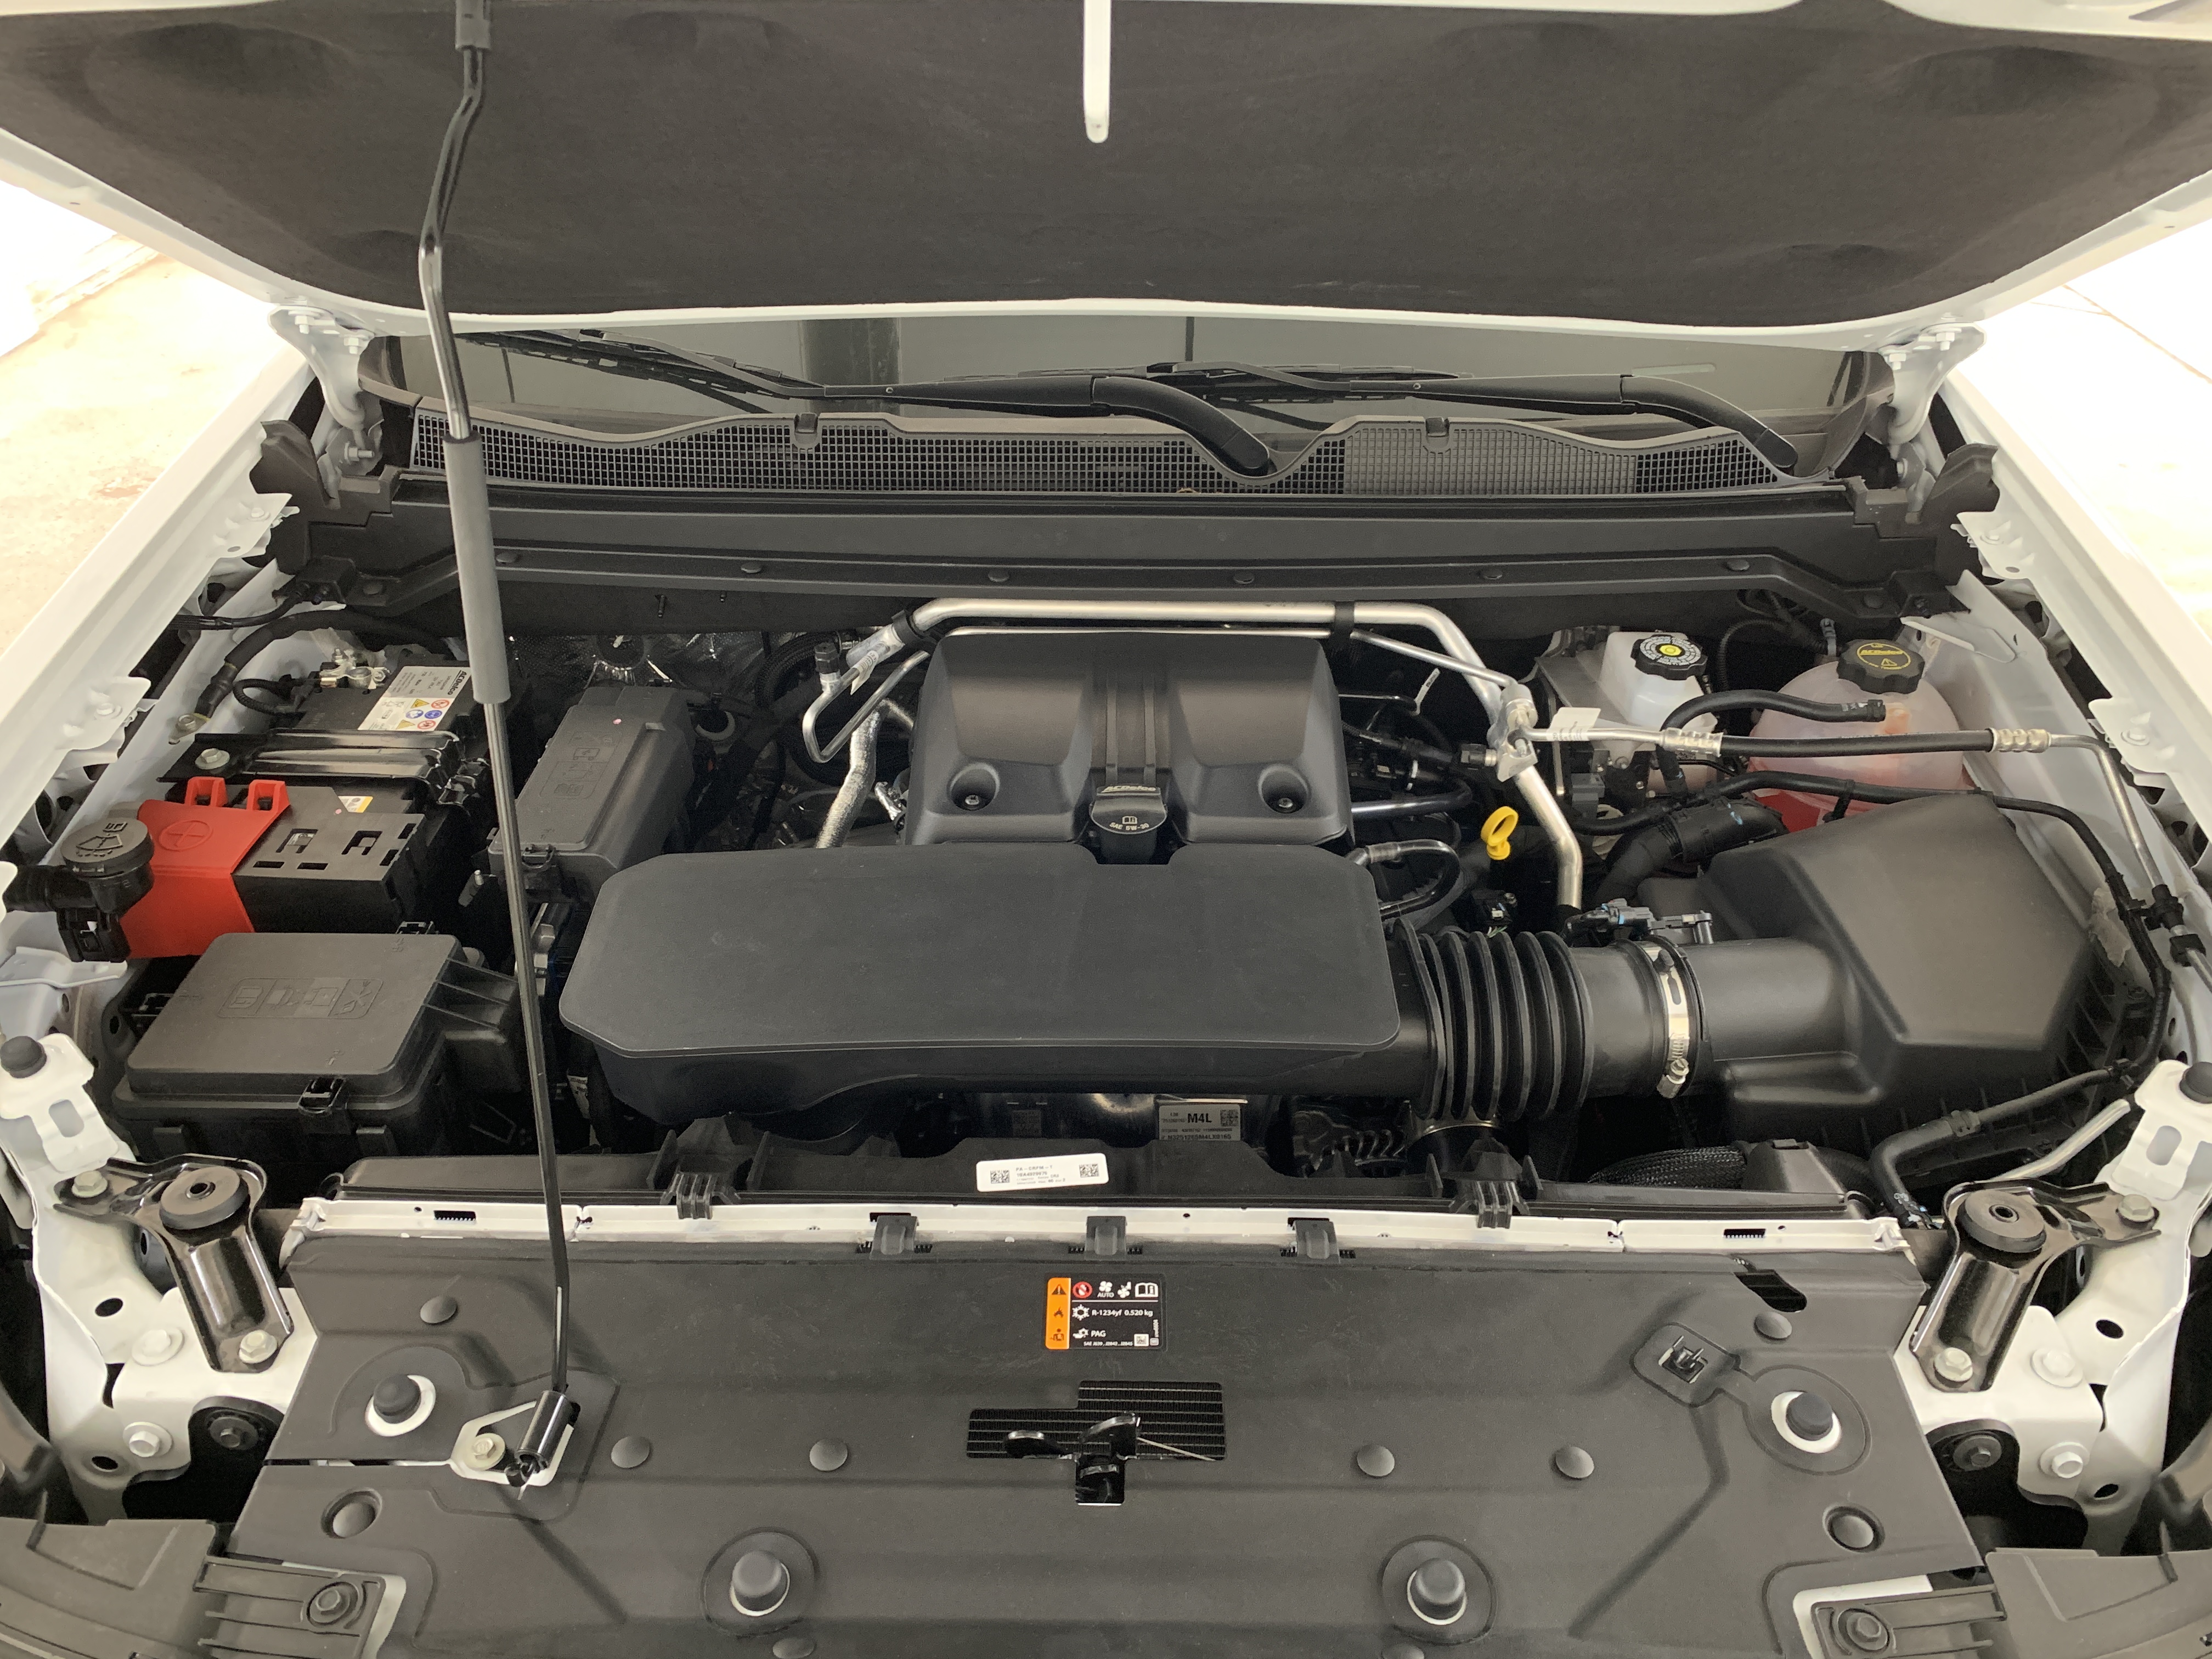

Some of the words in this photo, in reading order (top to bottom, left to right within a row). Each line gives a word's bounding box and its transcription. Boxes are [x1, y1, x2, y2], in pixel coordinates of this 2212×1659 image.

[447, 670, 467, 695] ACDelco
[1187, 1113, 1212, 1124] M4L
[1091, 1309, 1122, 1317] R-1234yf
[1144, 1309, 1154, 1317] kg
